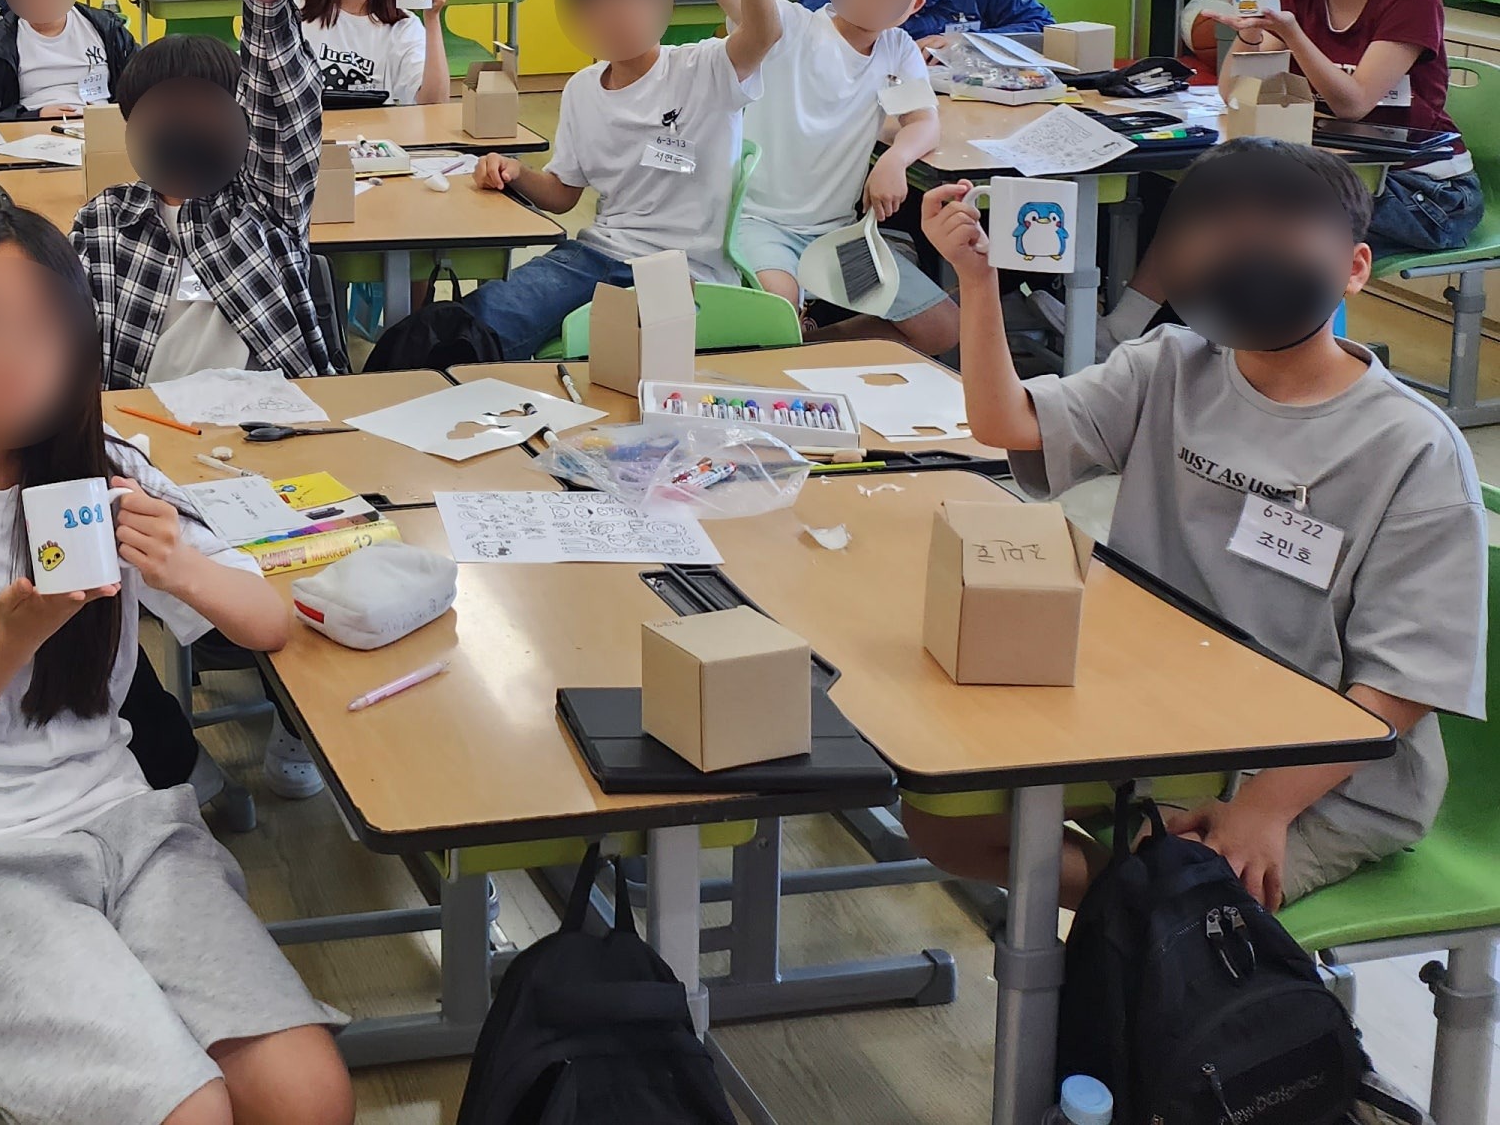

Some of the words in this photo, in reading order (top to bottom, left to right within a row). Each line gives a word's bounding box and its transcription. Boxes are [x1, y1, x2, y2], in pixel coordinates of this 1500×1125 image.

[320, 42, 374, 76] lucky
[656, 136, 686, 148] 6-3-13
[1177, 447, 1219, 475] JUST
[1218, 467, 1246, 488] AS
[63, 503, 104, 529] 101
[1263, 504, 1324, 540] 6-3-22
[1256, 530, 1312, 566] 조민호
